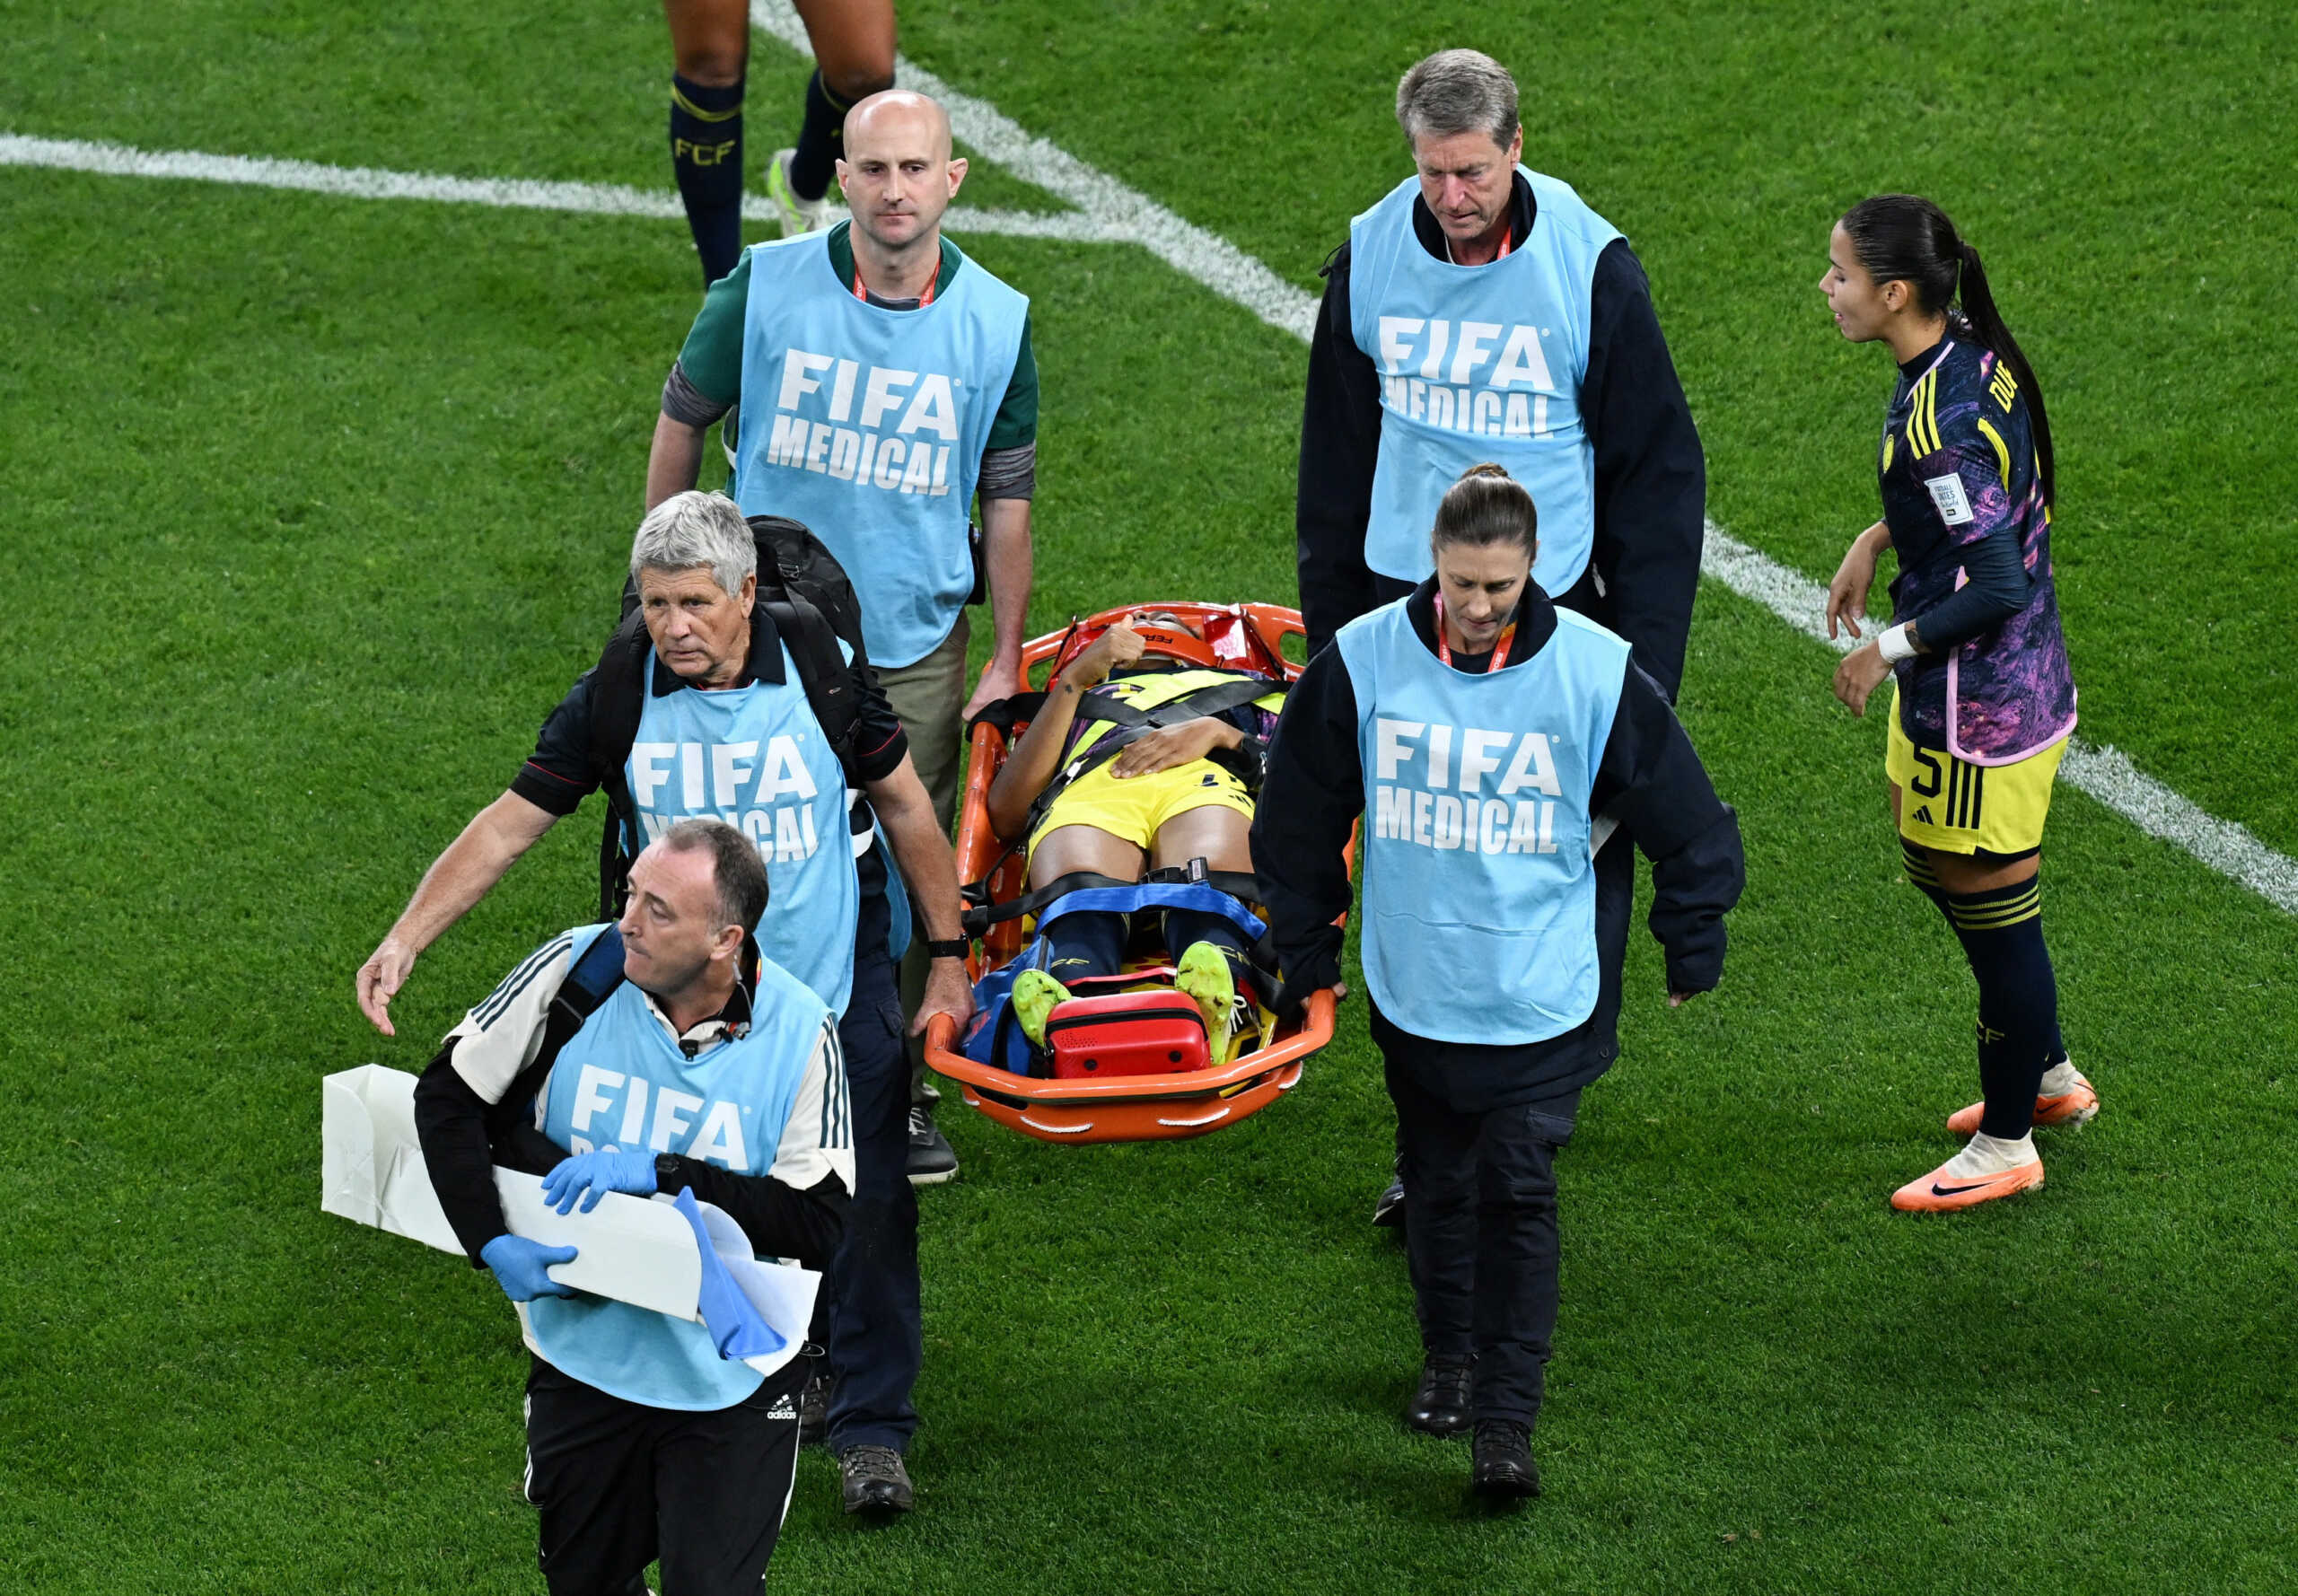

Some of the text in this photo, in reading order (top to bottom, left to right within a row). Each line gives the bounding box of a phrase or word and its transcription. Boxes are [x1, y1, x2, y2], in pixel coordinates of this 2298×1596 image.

[675, 137, 736, 166] FCF
[1378, 315, 1555, 390] FIFA
[777, 347, 958, 441] FIFA
[1385, 375, 1554, 439] MEDICAL
[767, 413, 951, 496] MEDICAL
[1142, 633, 1174, 645] FER
[632, 734, 818, 809] FIFA
[1375, 717, 1562, 797] FIFA
[1911, 743, 1943, 799] 5
[1375, 785, 1557, 855] MEDICAL
[570, 1063, 750, 1171] FIFA
[767, 1408, 797, 1420] adidas
